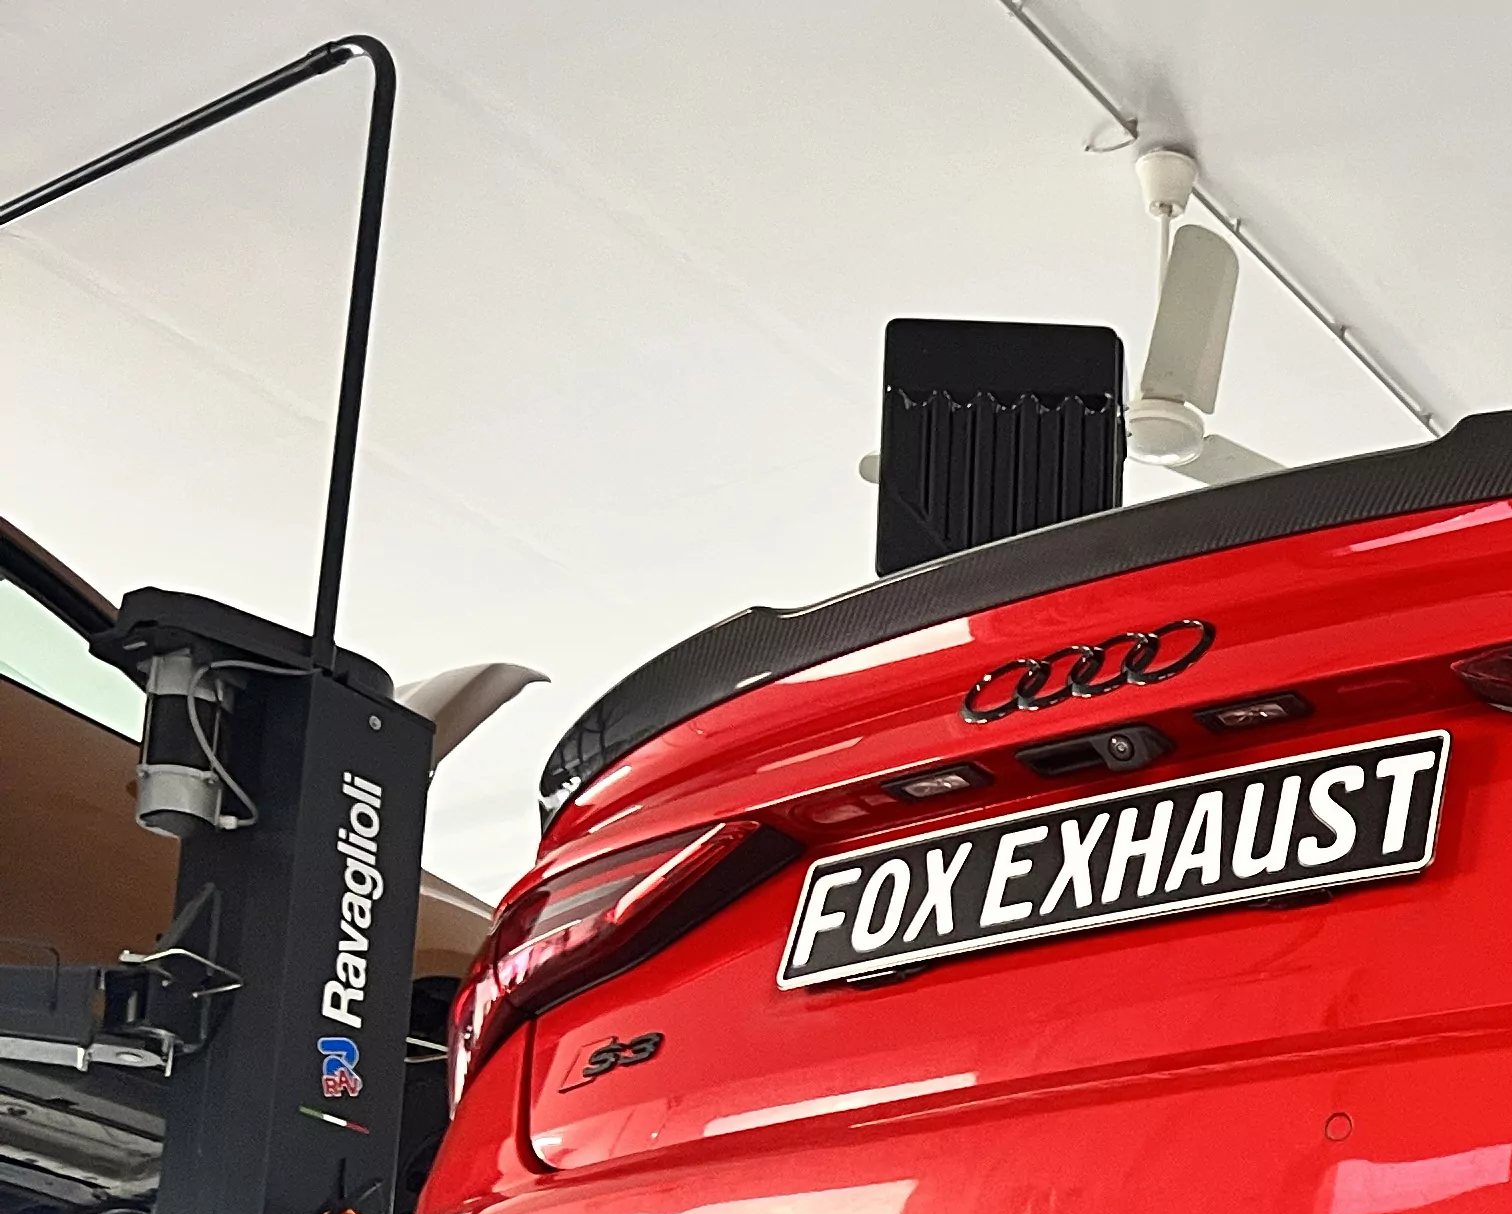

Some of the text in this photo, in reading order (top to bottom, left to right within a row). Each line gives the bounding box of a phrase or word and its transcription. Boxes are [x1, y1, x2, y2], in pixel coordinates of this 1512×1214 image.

[322, 772, 384, 1029] Ravaglioli
[791, 751, 1435, 967] FOX EXHAUST
[582, 1032, 665, 1078] S3
